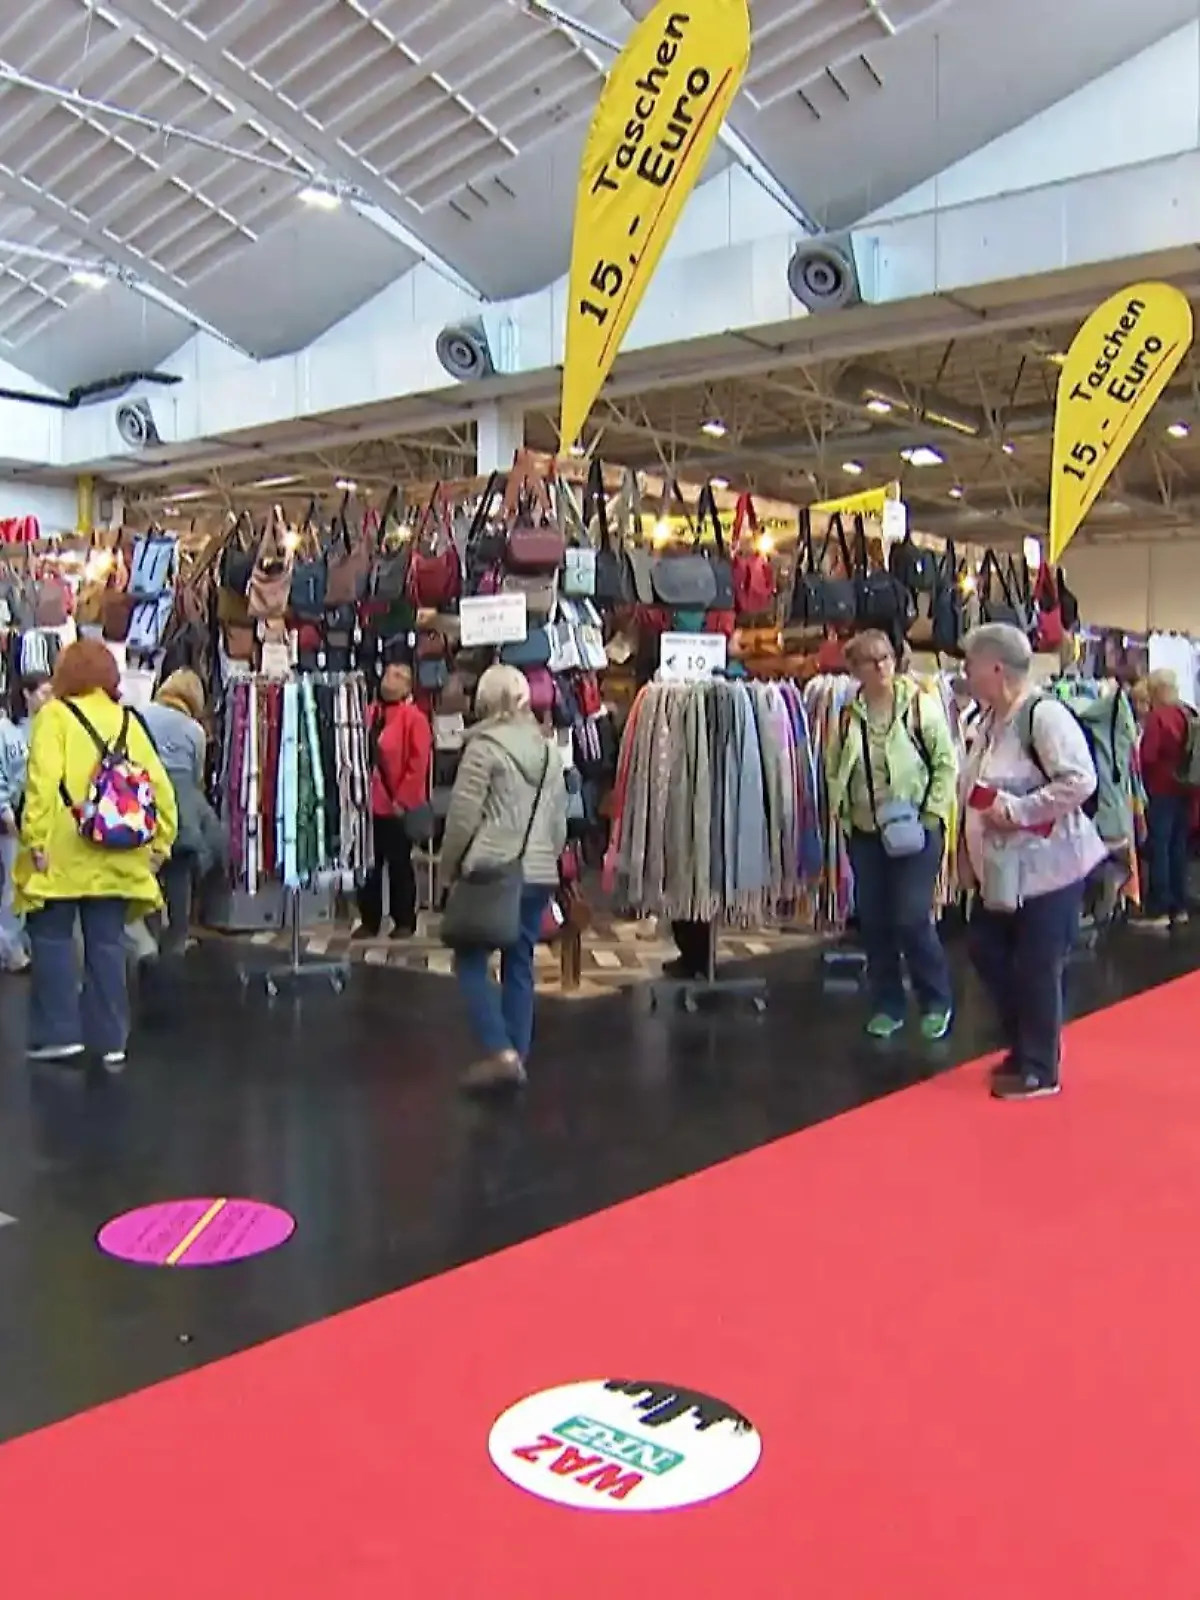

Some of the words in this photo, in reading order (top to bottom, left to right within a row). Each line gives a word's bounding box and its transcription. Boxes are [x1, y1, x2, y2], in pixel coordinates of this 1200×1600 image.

[591, 13, 690, 195] Taschen
[636, 67, 710, 187] Euro
[1069, 299, 1146, 402] Taschen
[1106, 335, 1162, 403] Euro
[511, 1434, 644, 1500] WAZ
[559, 1416, 679, 1471] NRZ
